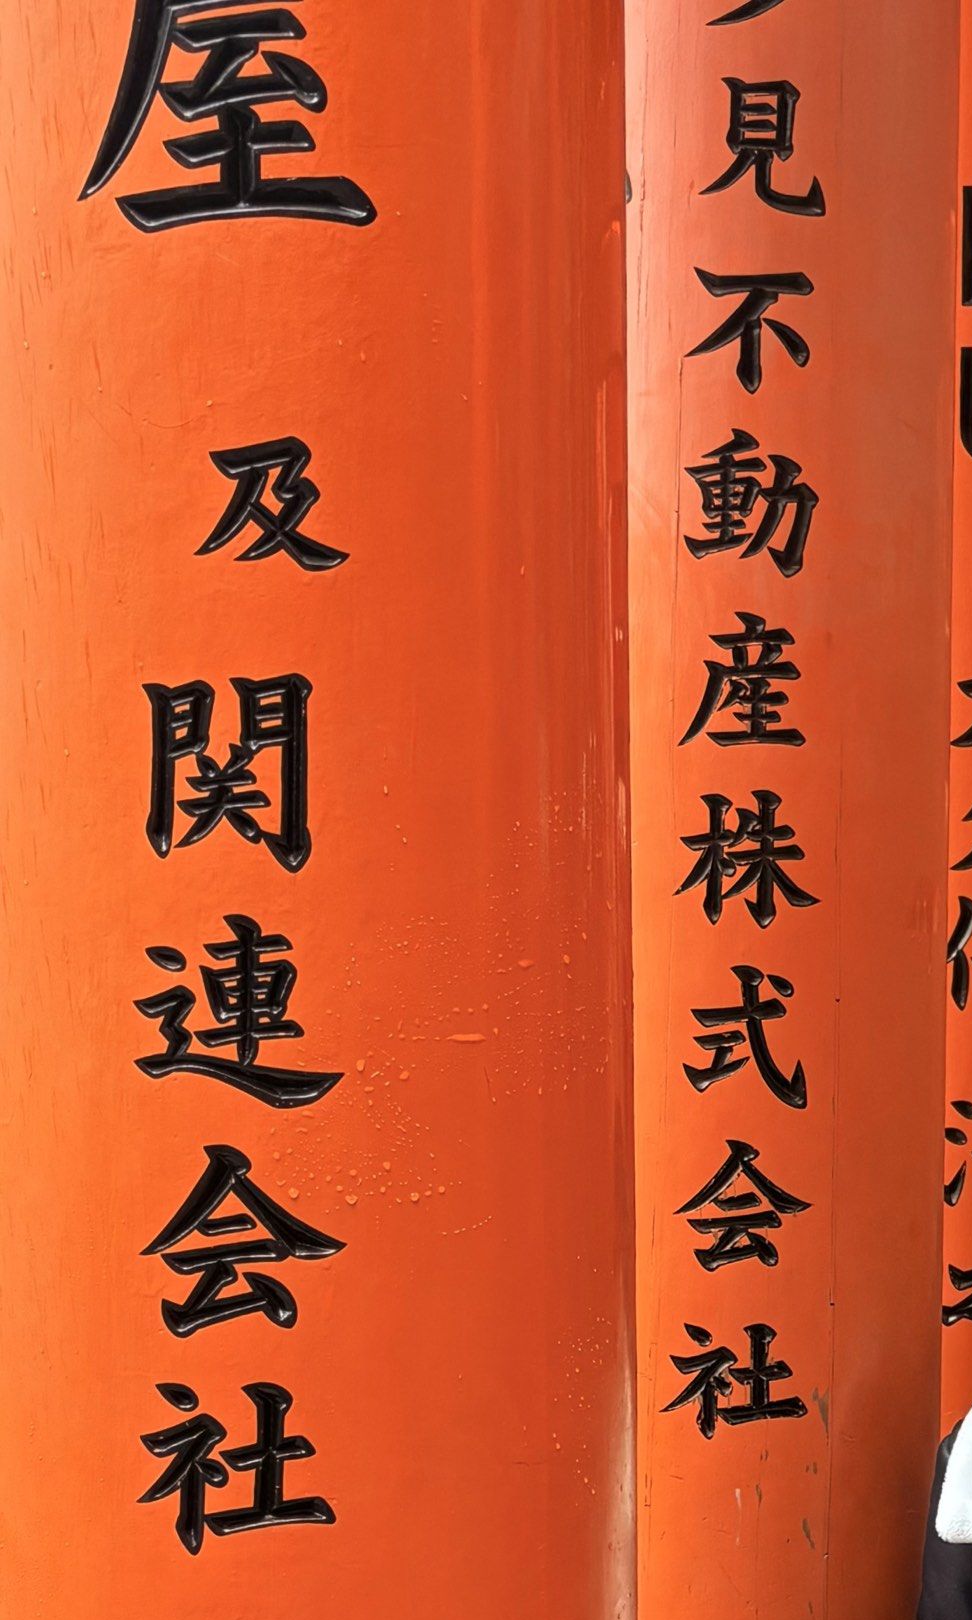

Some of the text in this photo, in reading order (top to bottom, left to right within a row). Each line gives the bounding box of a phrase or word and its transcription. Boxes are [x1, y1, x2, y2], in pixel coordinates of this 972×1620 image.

[664, 0, 832, 1440] 見不動産株式会社
